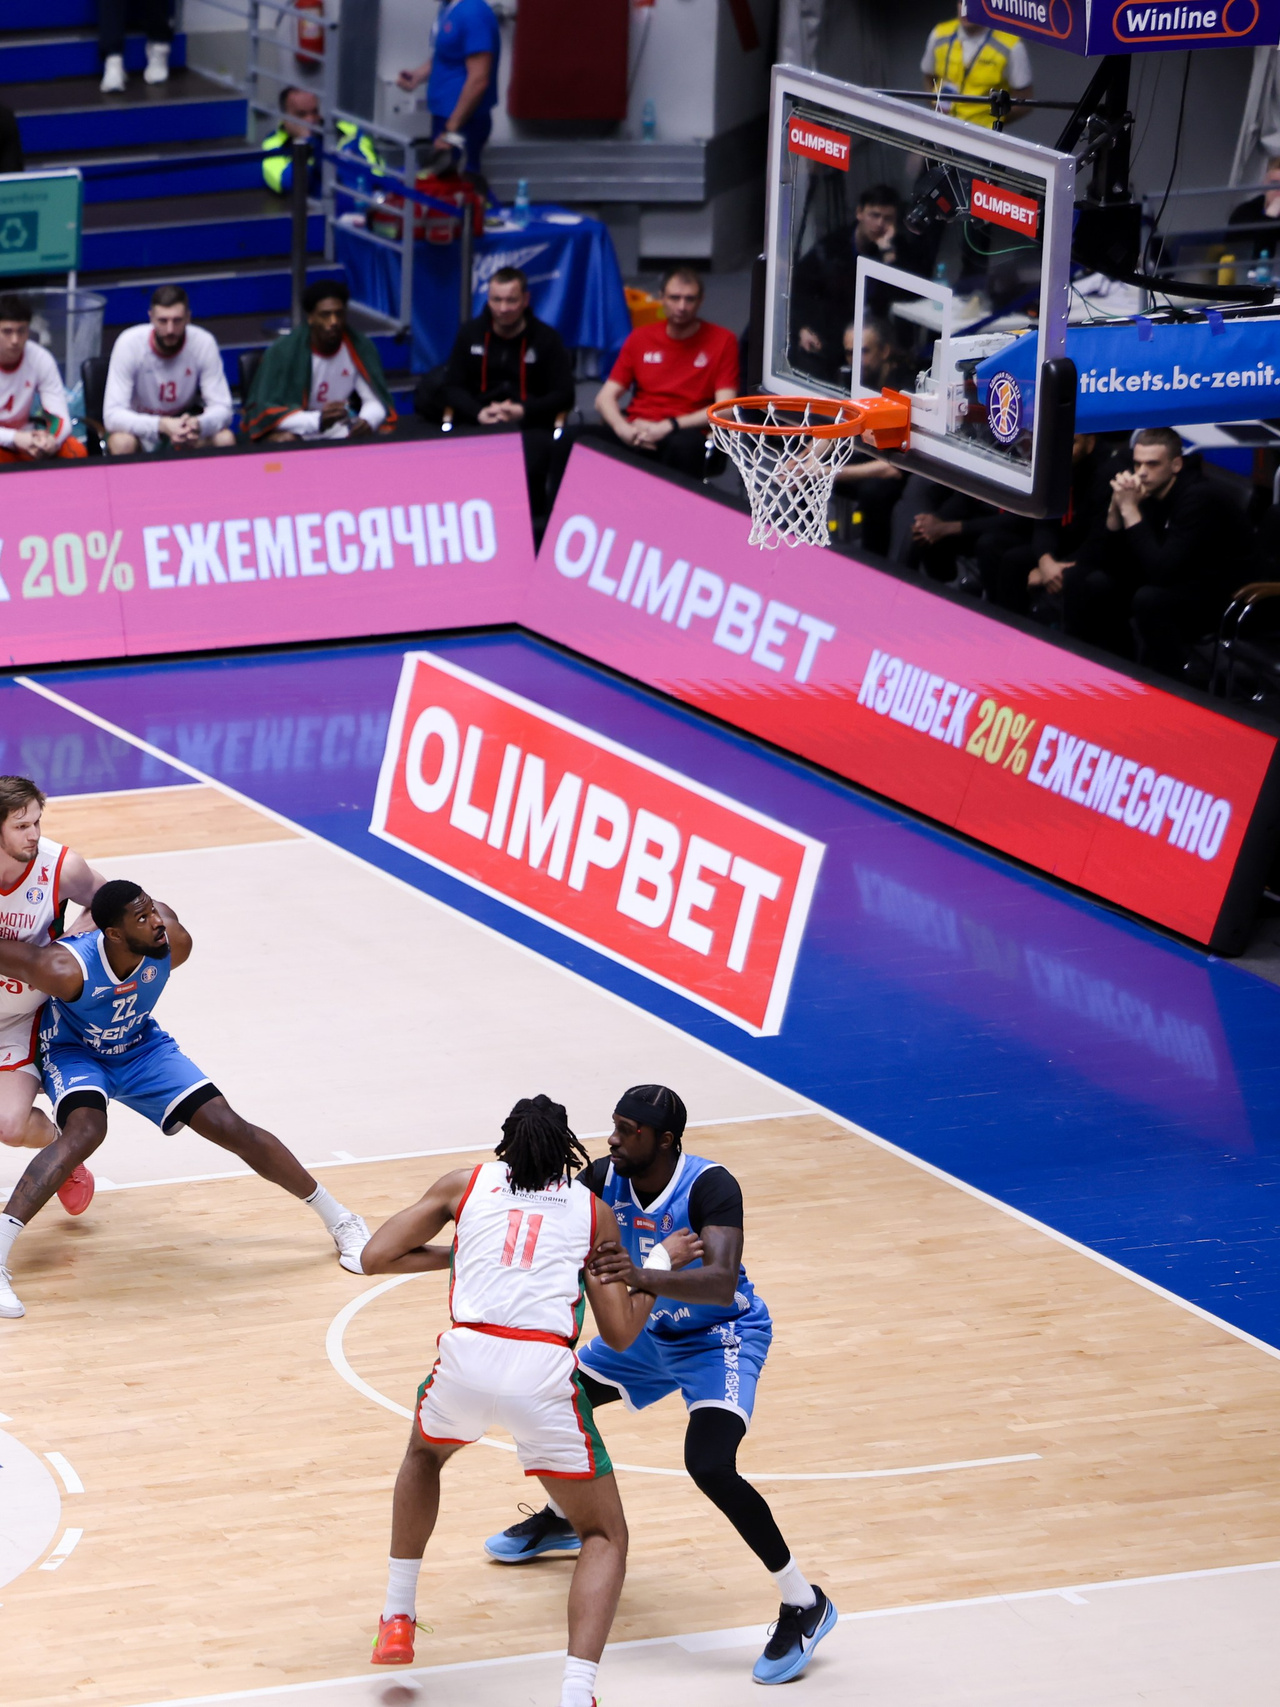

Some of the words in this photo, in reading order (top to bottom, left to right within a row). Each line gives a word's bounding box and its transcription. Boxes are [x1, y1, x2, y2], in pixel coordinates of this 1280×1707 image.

[1126, 7, 1217, 32] Winline
[790, 128, 848, 160] OLIMPBET
[973, 190, 1036, 226] OLIMPBET
[158, 381, 178, 403] 13
[316, 382, 329, 403] 2
[19, 529, 135, 600] 20%
[142, 498, 498, 590] ЕЖЕМЕСЯЧНО
[554, 514, 837, 684] OLIMPBET
[856, 648, 978, 750] КЭШБЕК
[965, 698, 1036, 776] 20%
[1027, 724, 1232, 861] ЕЖЕМЕСЯЧНО
[405, 705, 783, 974] OLIMPBET
[111, 993, 139, 1024] 22
[500, 1208, 544, 1270] 11
